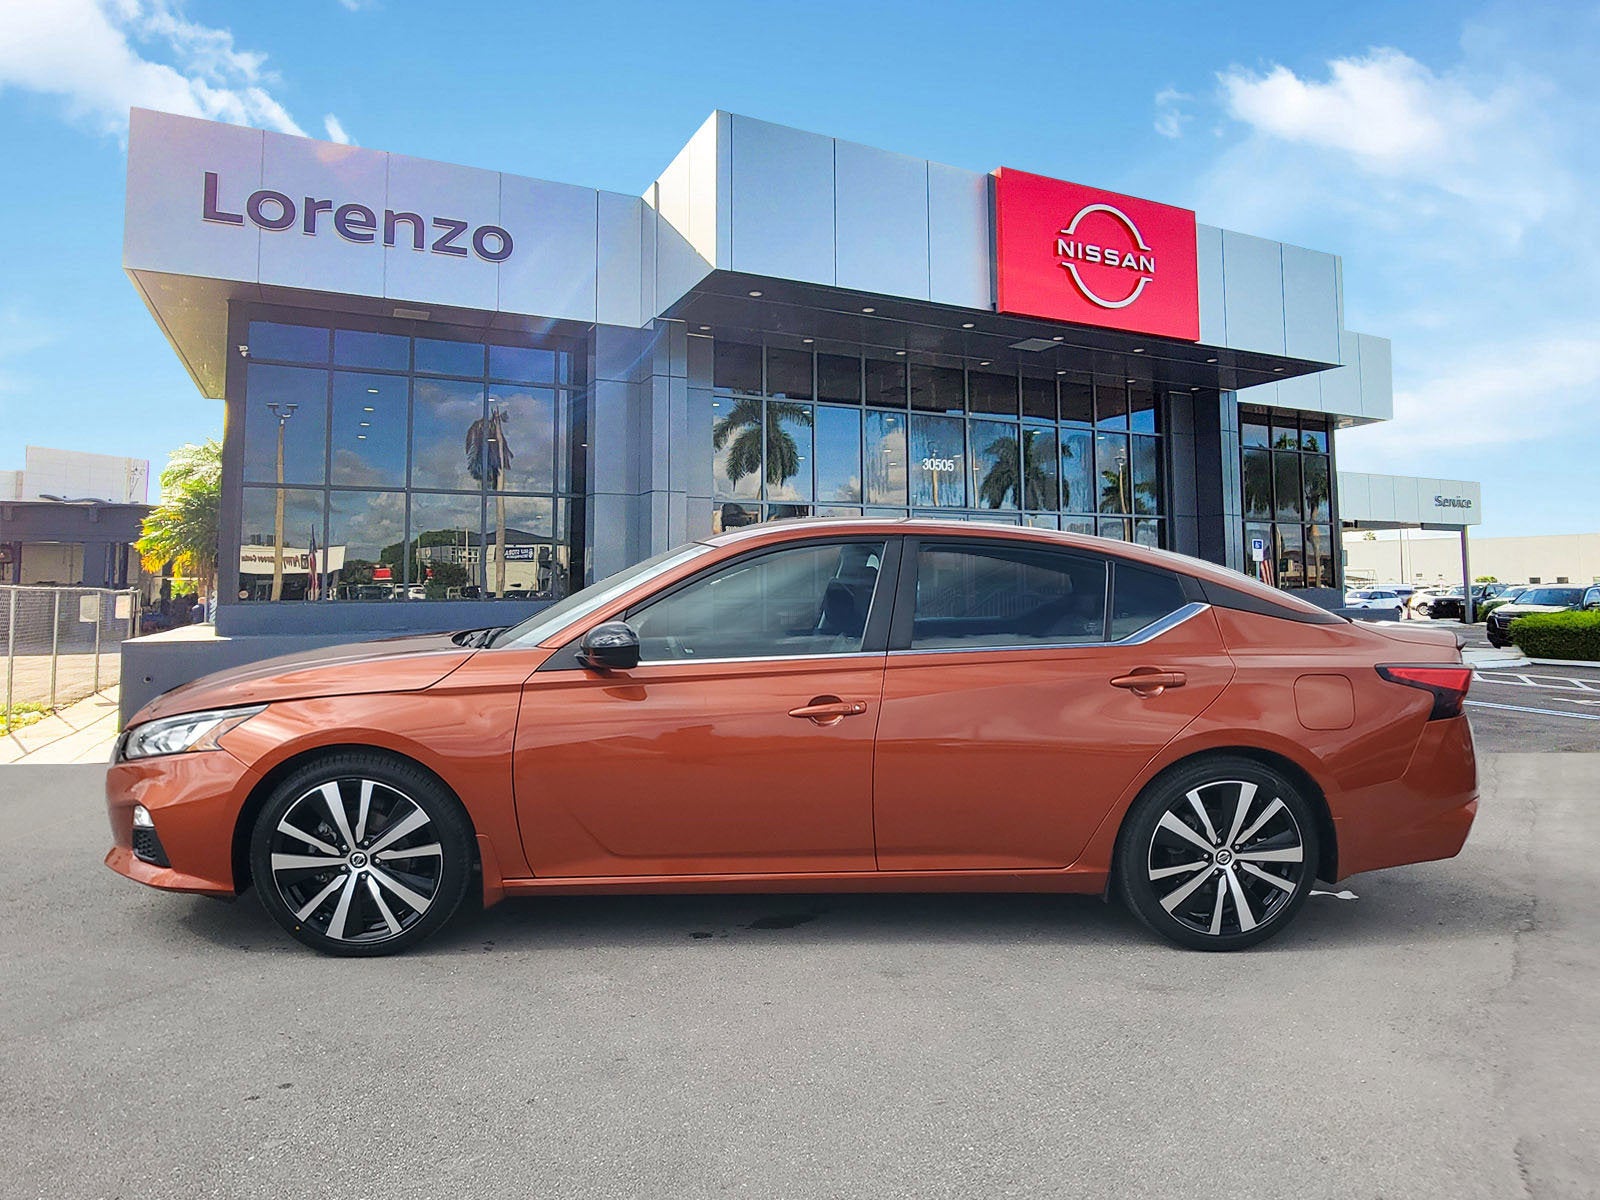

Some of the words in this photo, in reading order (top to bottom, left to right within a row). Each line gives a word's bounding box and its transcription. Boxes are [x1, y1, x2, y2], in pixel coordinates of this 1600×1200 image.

[202, 171, 514, 262] Lorenzo
[1057, 238, 1155, 273] NISSAN
[922, 458, 954, 471] 30505
[1434, 495, 1472, 508] Service
